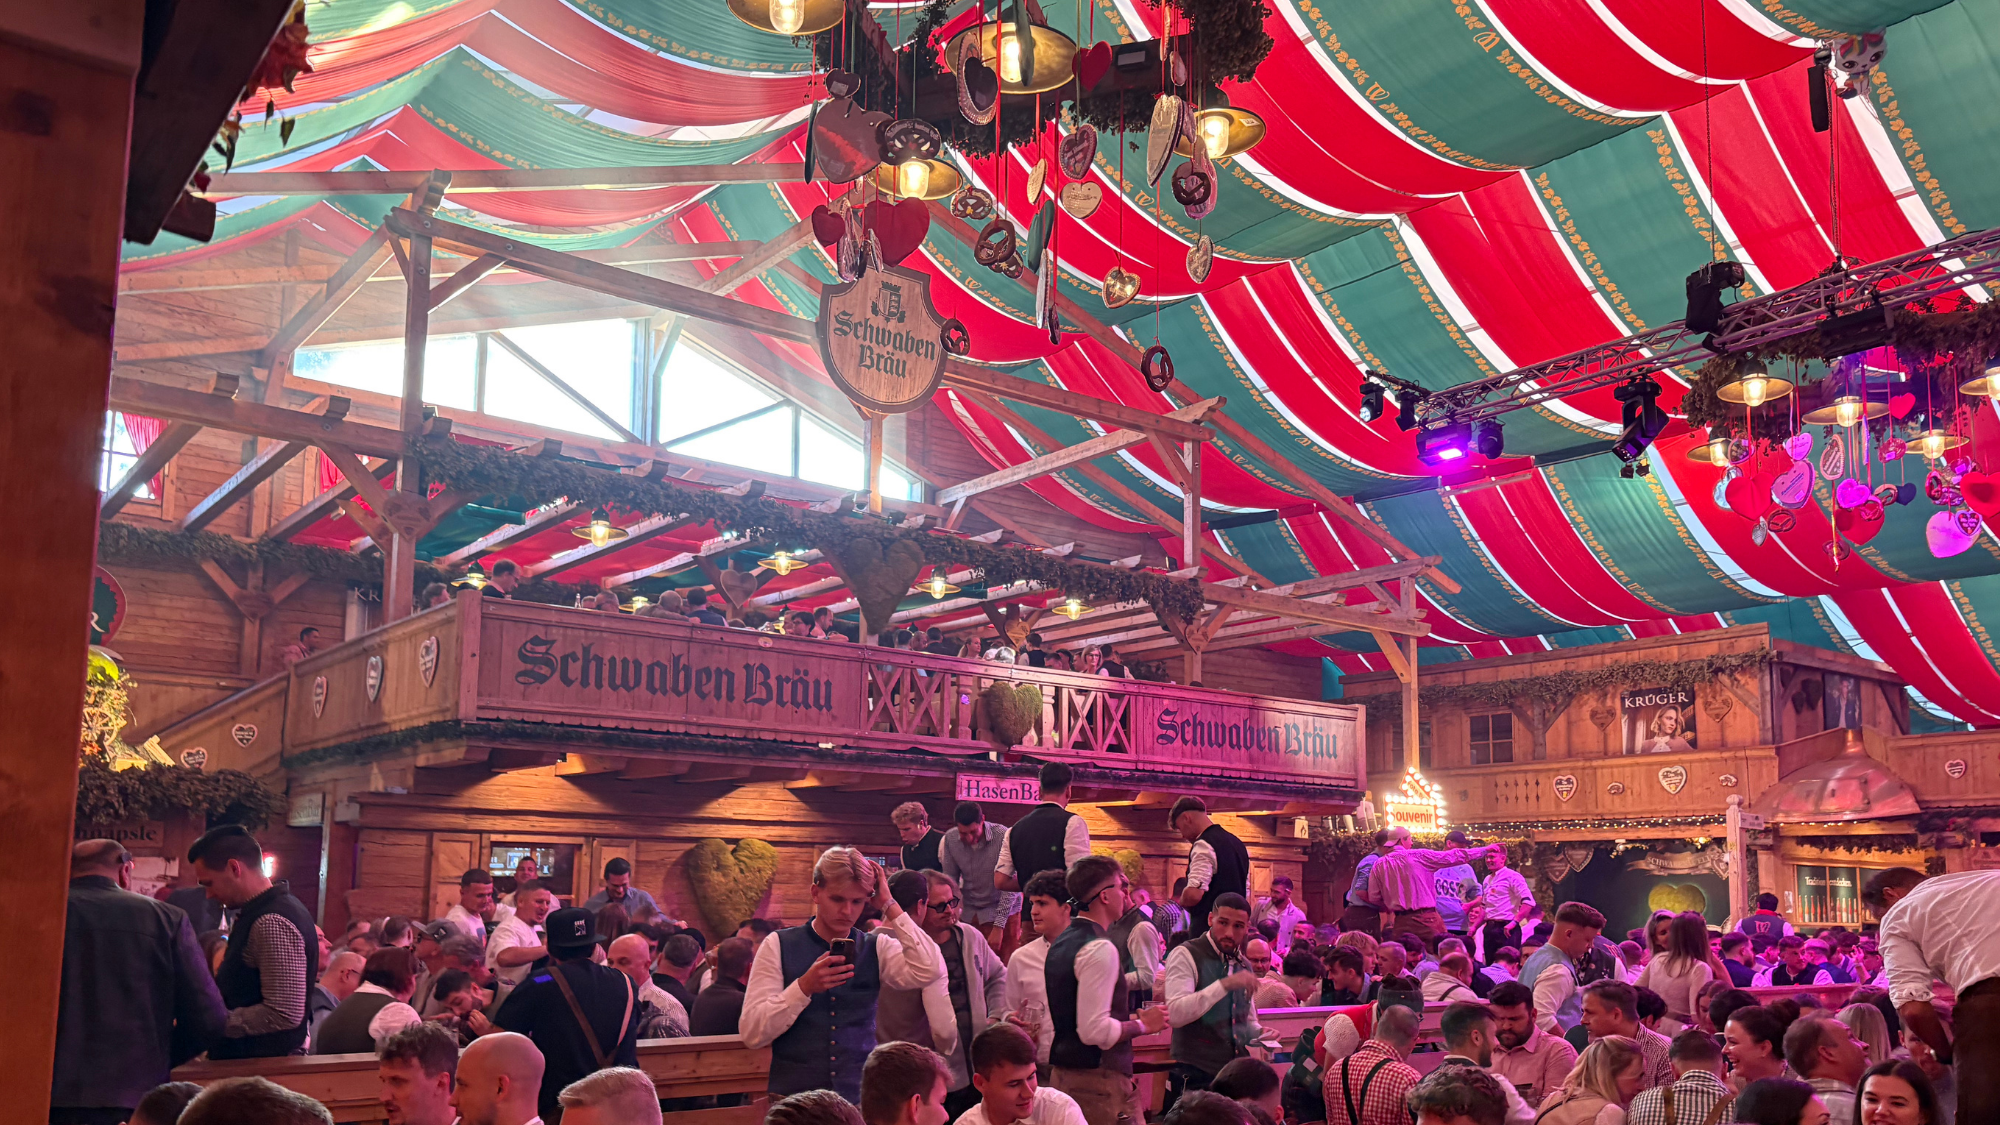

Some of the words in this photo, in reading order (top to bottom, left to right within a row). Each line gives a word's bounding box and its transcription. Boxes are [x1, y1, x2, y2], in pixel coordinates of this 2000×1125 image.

[833, 310, 936, 361] Schwaben
[858, 343, 907, 379] Bräu
[514, 634, 736, 704] Schwaben
[742, 661, 834, 713] Bräu
[1624, 692, 1689, 708] KRÜGER
[1156, 707, 1281, 755] Schwaben
[1284, 722, 1338, 760] Bräu
[965, 779, 1041, 801] HasenBa
